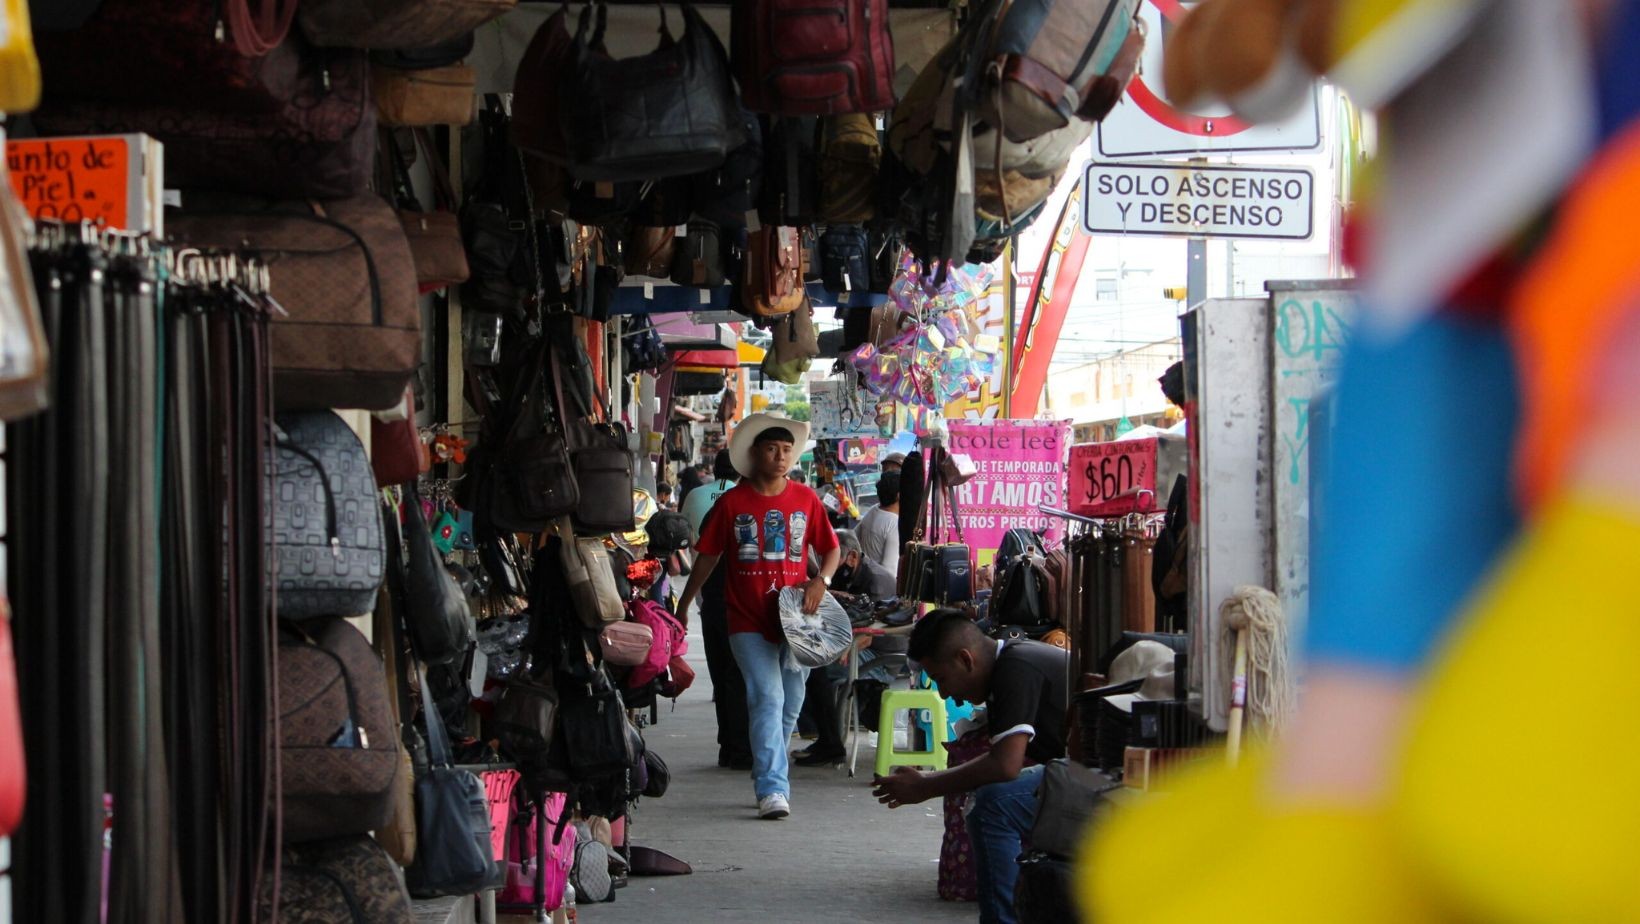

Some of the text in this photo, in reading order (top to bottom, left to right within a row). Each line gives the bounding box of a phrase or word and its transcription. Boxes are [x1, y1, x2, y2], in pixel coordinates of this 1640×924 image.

[83, 142, 114, 170] de
[1097, 174, 1302, 200] SOLO ASCENSO
[1116, 202, 1283, 226] Y DESCENSO
[949, 428, 1056, 450] icole lee
[991, 461, 1060, 475] TEMPORADA
[1085, 454, 1132, 504] $60
[1000, 516, 1057, 530] PRECIOS
